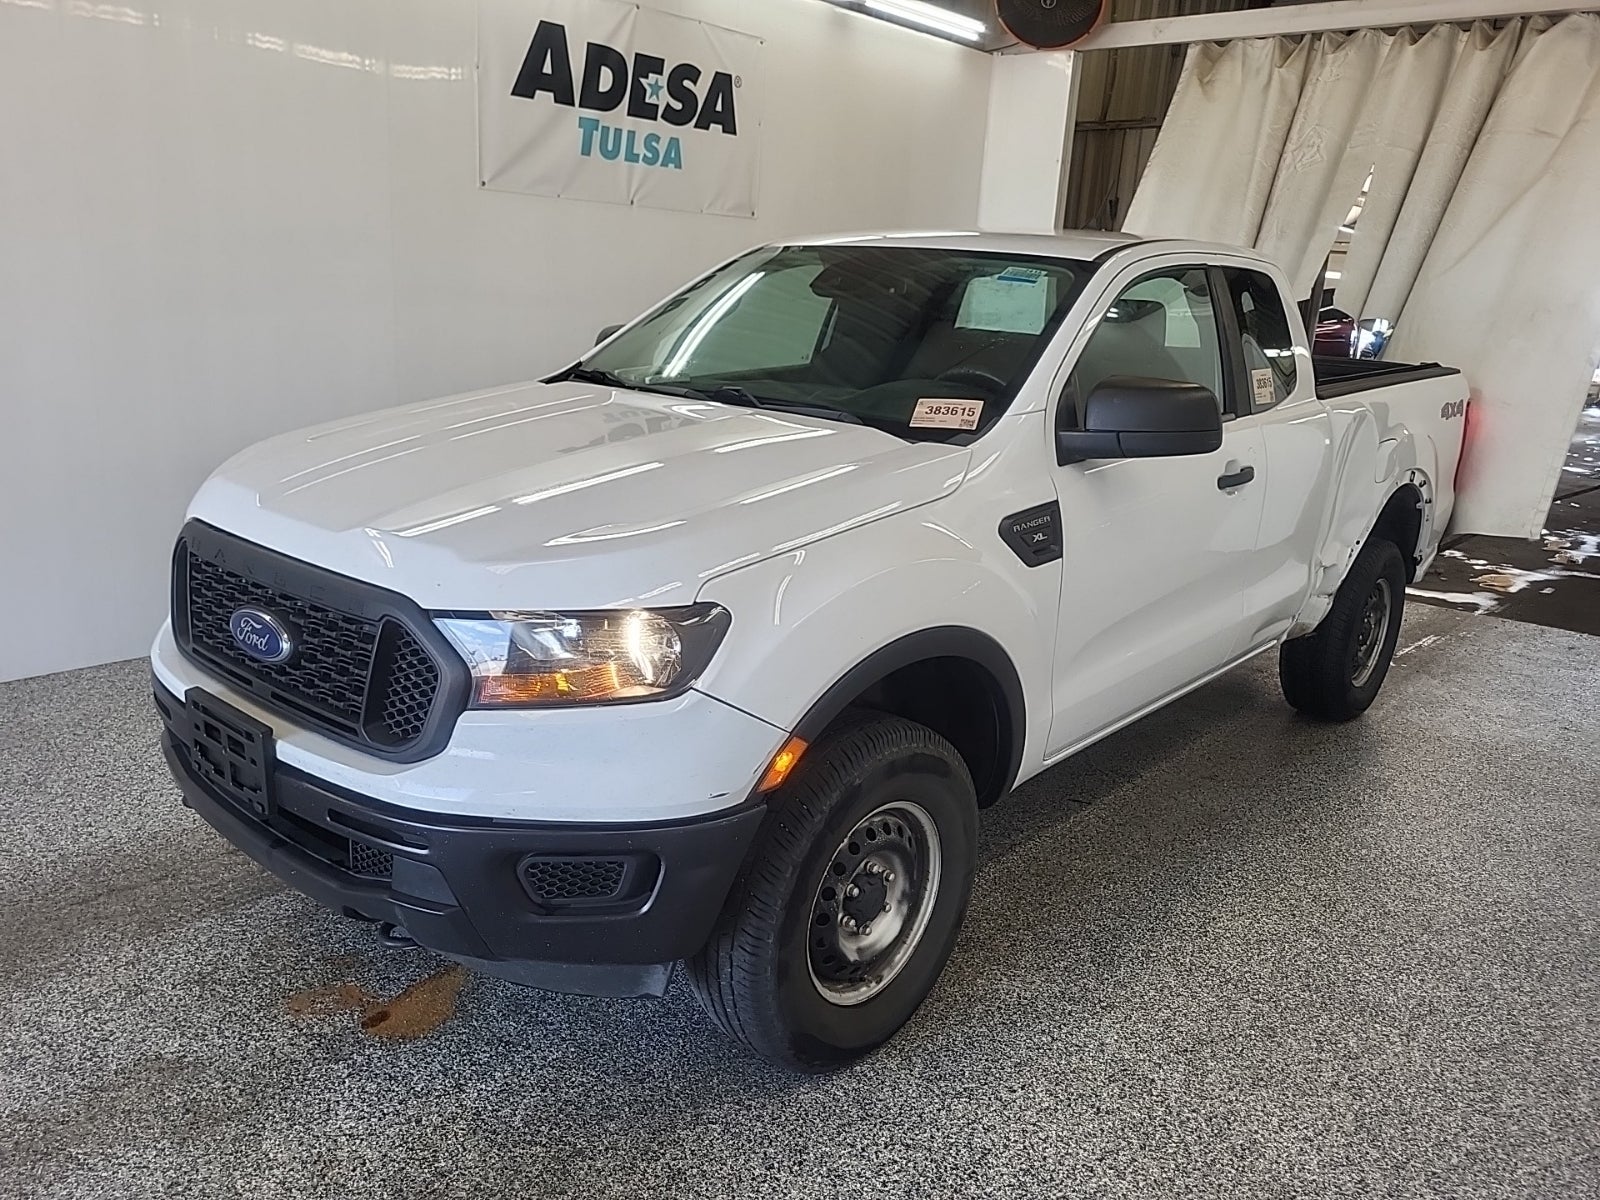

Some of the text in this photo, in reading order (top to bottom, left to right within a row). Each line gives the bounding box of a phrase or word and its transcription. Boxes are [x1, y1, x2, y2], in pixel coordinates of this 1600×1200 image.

[511, 20, 738, 136] ADESA
[578, 116, 682, 170] TULSA
[924, 405, 977, 418] 383615
[1013, 515, 1051, 533] RANGER
[1032, 532, 1048, 543] XL
[236, 616, 270, 652] Ford
